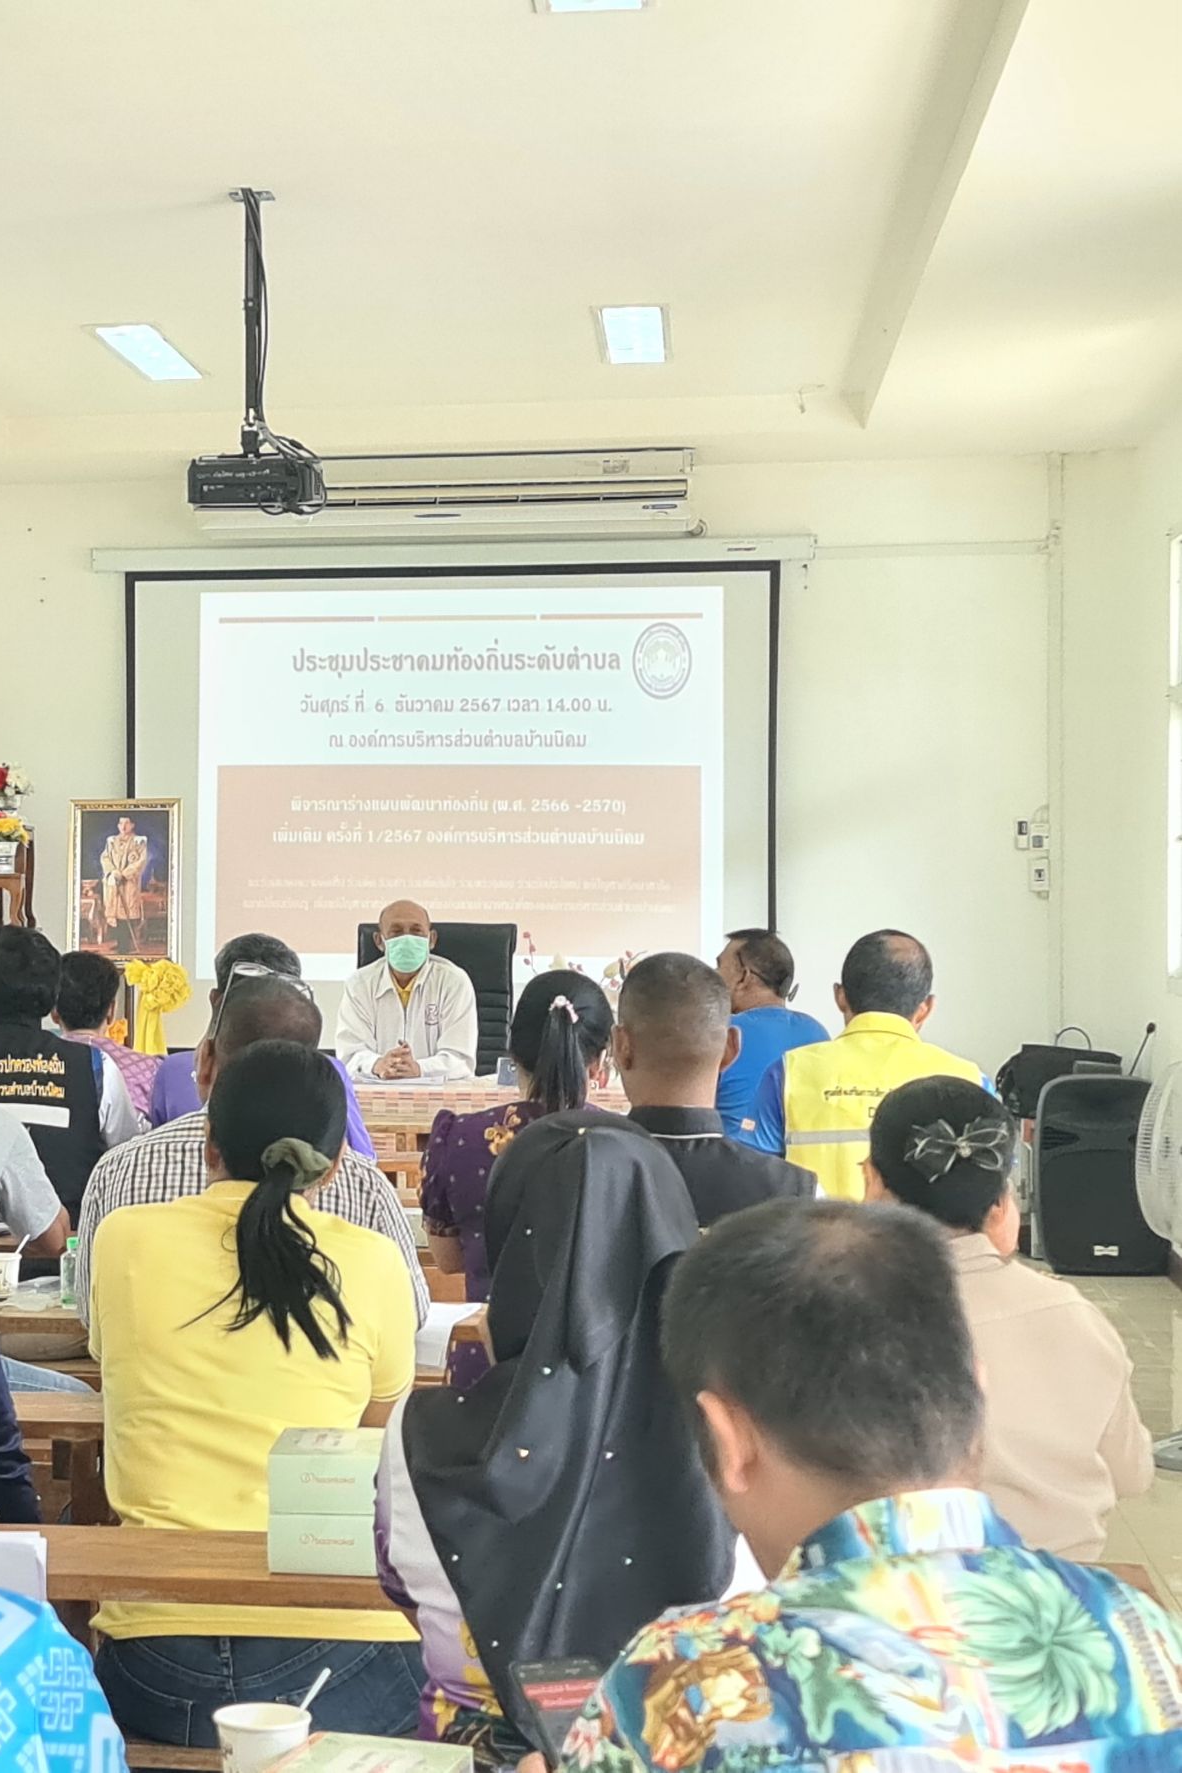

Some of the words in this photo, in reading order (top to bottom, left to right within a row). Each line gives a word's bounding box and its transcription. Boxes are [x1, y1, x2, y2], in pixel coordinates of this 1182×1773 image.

[292, 639, 621, 678] ประชุมประชาคมท้องถิ่นระดับตำบล
[300, 693, 350, 717] วันศุกร์
[354, 690, 365, 713] ที่
[374, 698, 385, 713] 6
[394, 694, 455, 713] ธันวาคม
[459, 697, 501, 713] 2567
[507, 698, 540, 713] เวลา
[546, 697, 592, 713] 14.00
[598, 697, 613, 713] น.
[328, 733, 344, 749] ณ
[348, 728, 587, 749] องค์การบริหารส่วนตำบลบ้านนิคม
[291, 790, 488, 814] พิจารณาร่างแผนพัฒนาท้องถิ่น
[492, 798, 527, 815] (พ.ศ.
[531, 798, 570, 813] 2566
[575, 798, 627, 815] -2570)
[326, 820, 362, 843] ครั้งที่
[367, 828, 422, 844] 1/2567
[426, 824, 646, 846] องค์การบริหารส่วนตำบลบ้านนิคม
